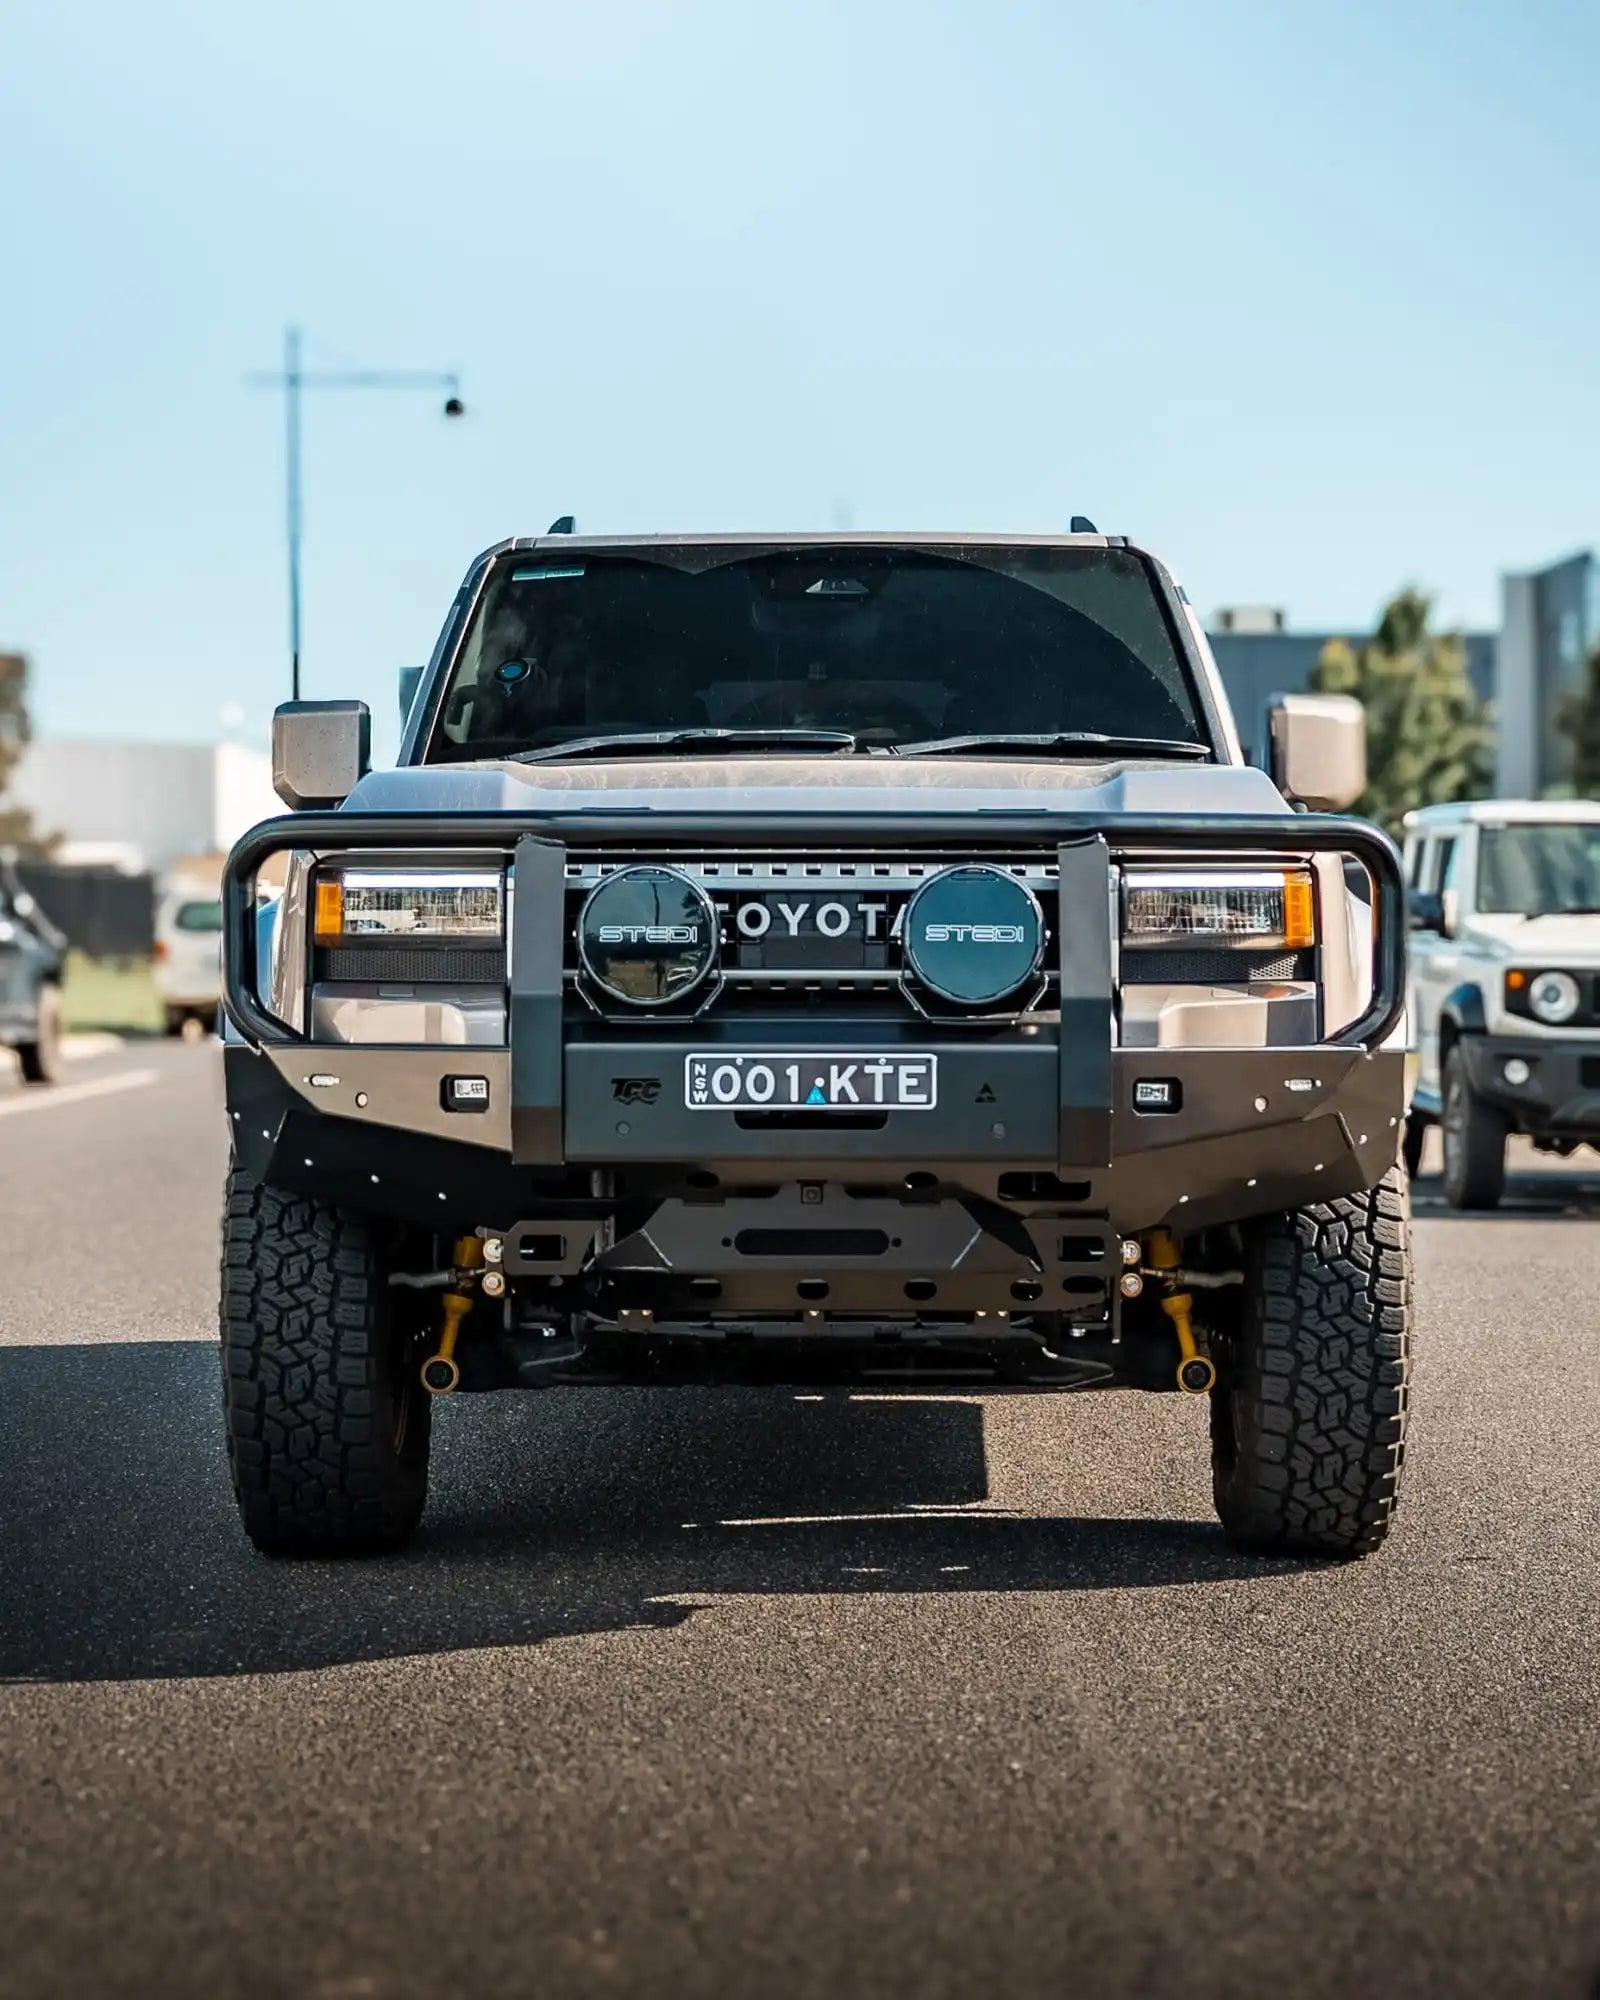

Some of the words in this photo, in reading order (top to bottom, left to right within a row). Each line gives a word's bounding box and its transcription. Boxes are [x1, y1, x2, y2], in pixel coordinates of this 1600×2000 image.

[599, 925, 698, 944] STEDI
[925, 924, 1024, 943] STEDI
[692, 1063, 709, 1104] NSW
